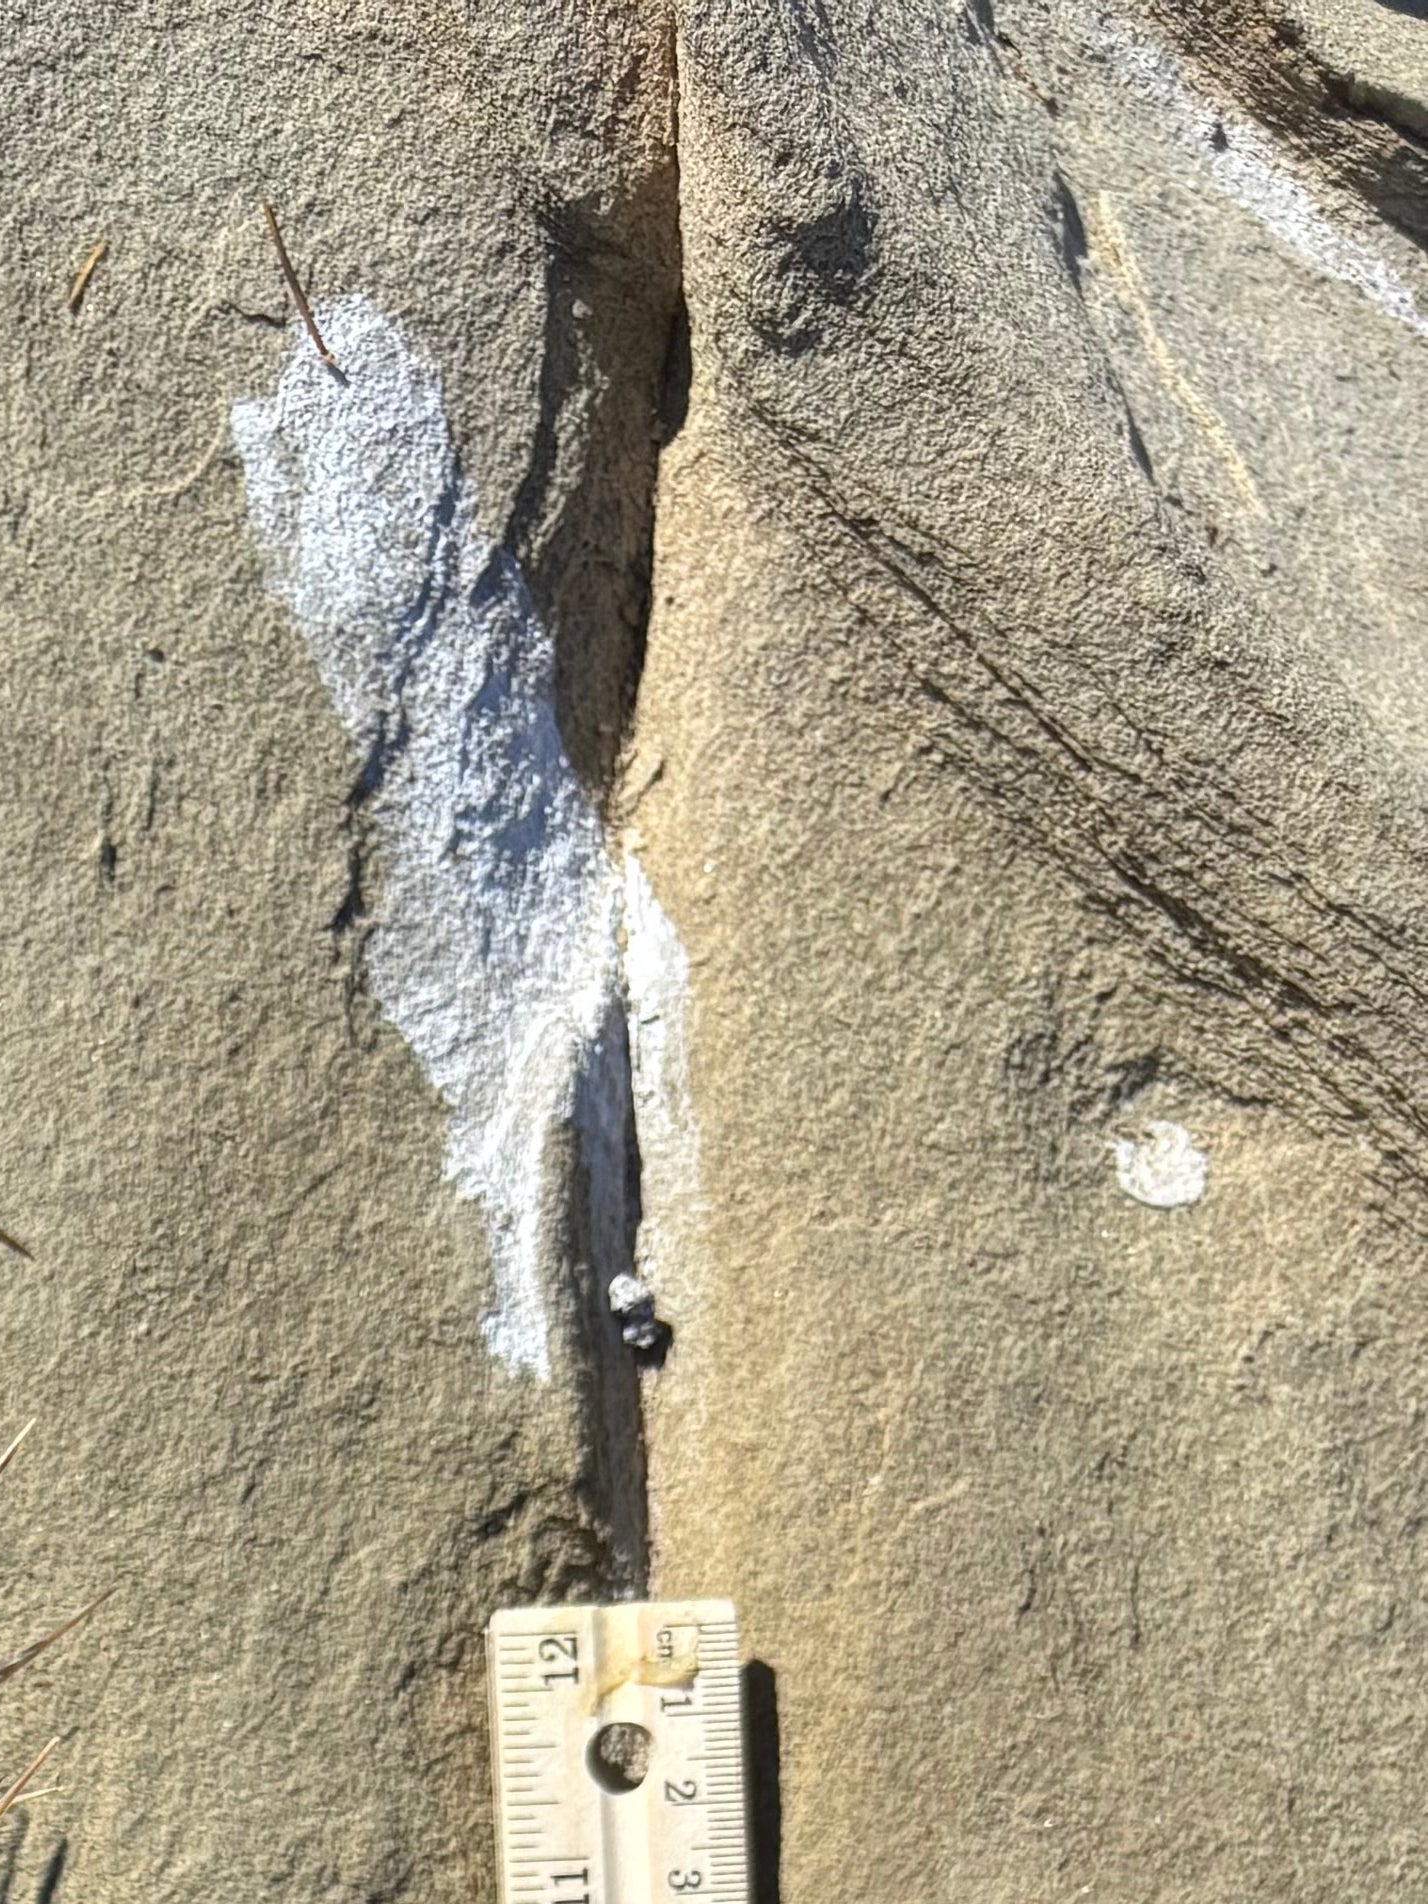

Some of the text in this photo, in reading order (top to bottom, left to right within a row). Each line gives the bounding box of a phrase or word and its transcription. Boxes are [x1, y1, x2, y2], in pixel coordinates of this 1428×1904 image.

[539, 1636, 579, 1684] 12
[660, 1696, 692, 1712] 1
[665, 1779, 697, 1803] 2
[668, 1869, 702, 1893] 3
